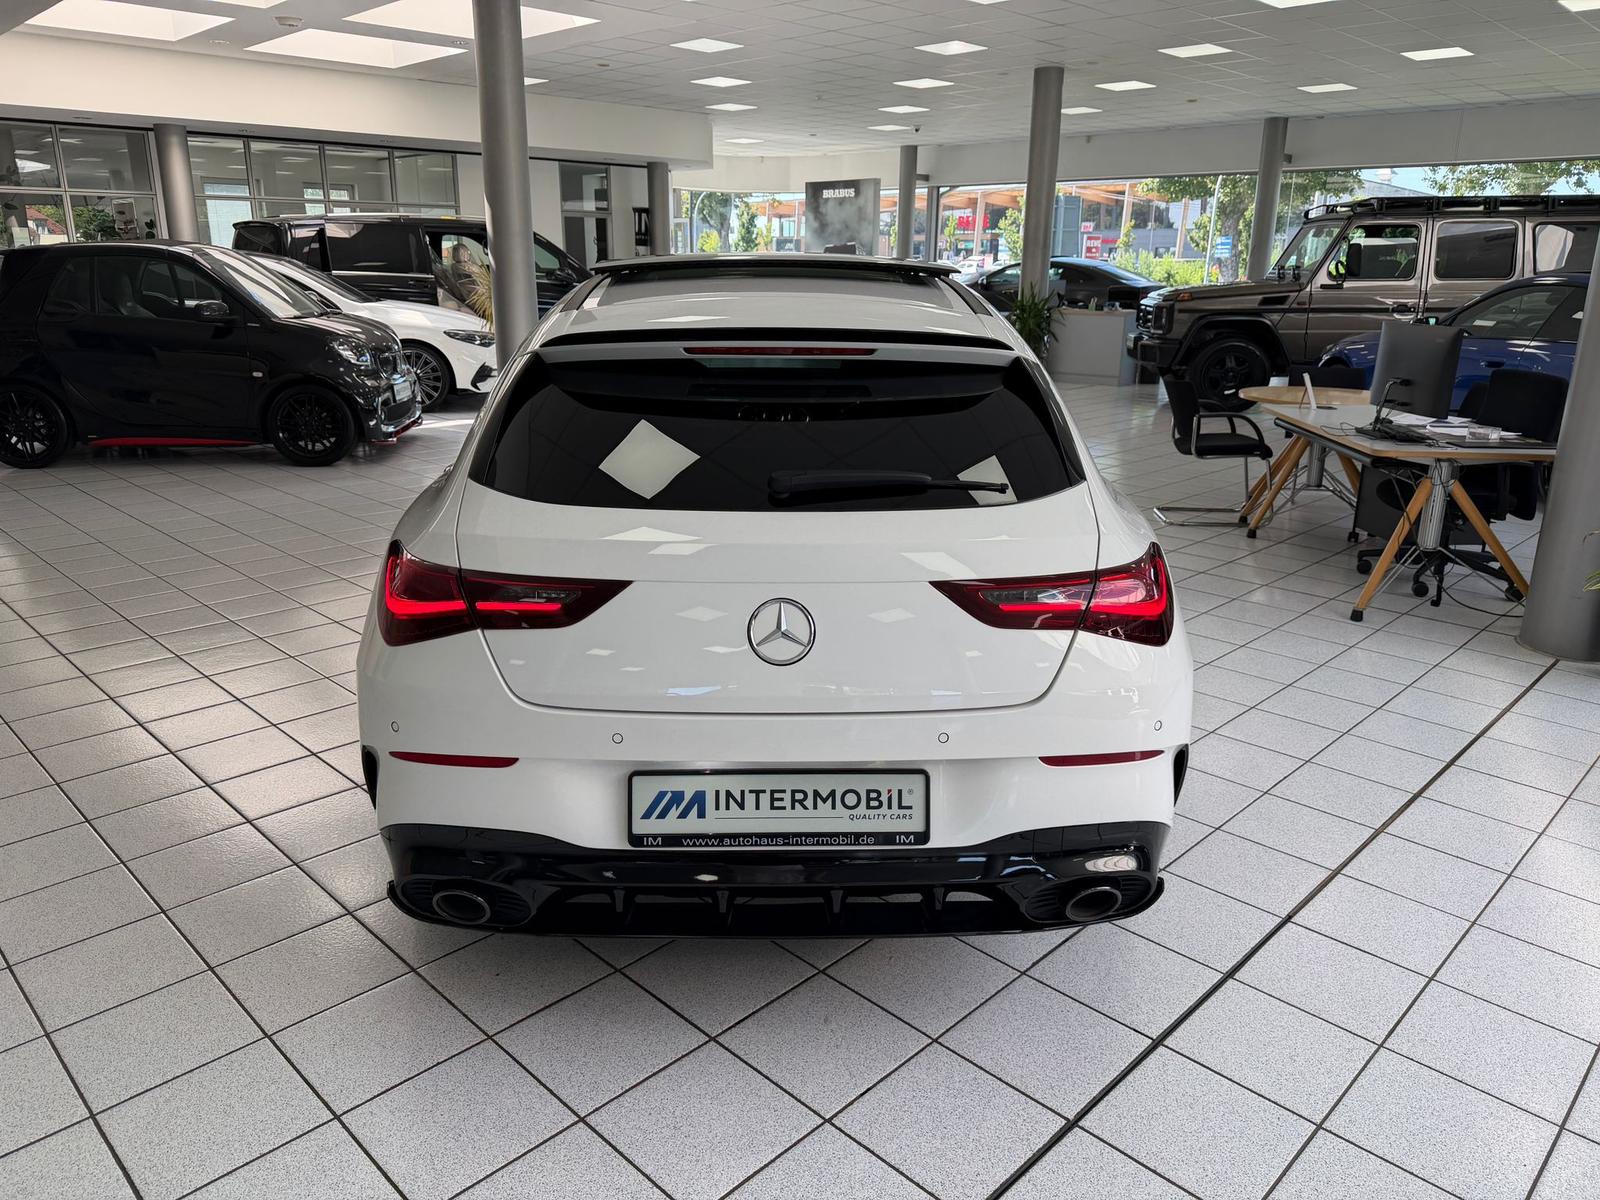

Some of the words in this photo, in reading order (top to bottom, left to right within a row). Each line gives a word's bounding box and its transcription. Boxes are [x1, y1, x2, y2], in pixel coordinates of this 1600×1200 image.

[822, 188, 856, 199] BRABUS
[848, 813, 887, 821] QUALITY
[643, 837, 662, 846] IM
[682, 834, 875, 847] www.autohaus-intermobil.de
[896, 834, 914, 844] IM
